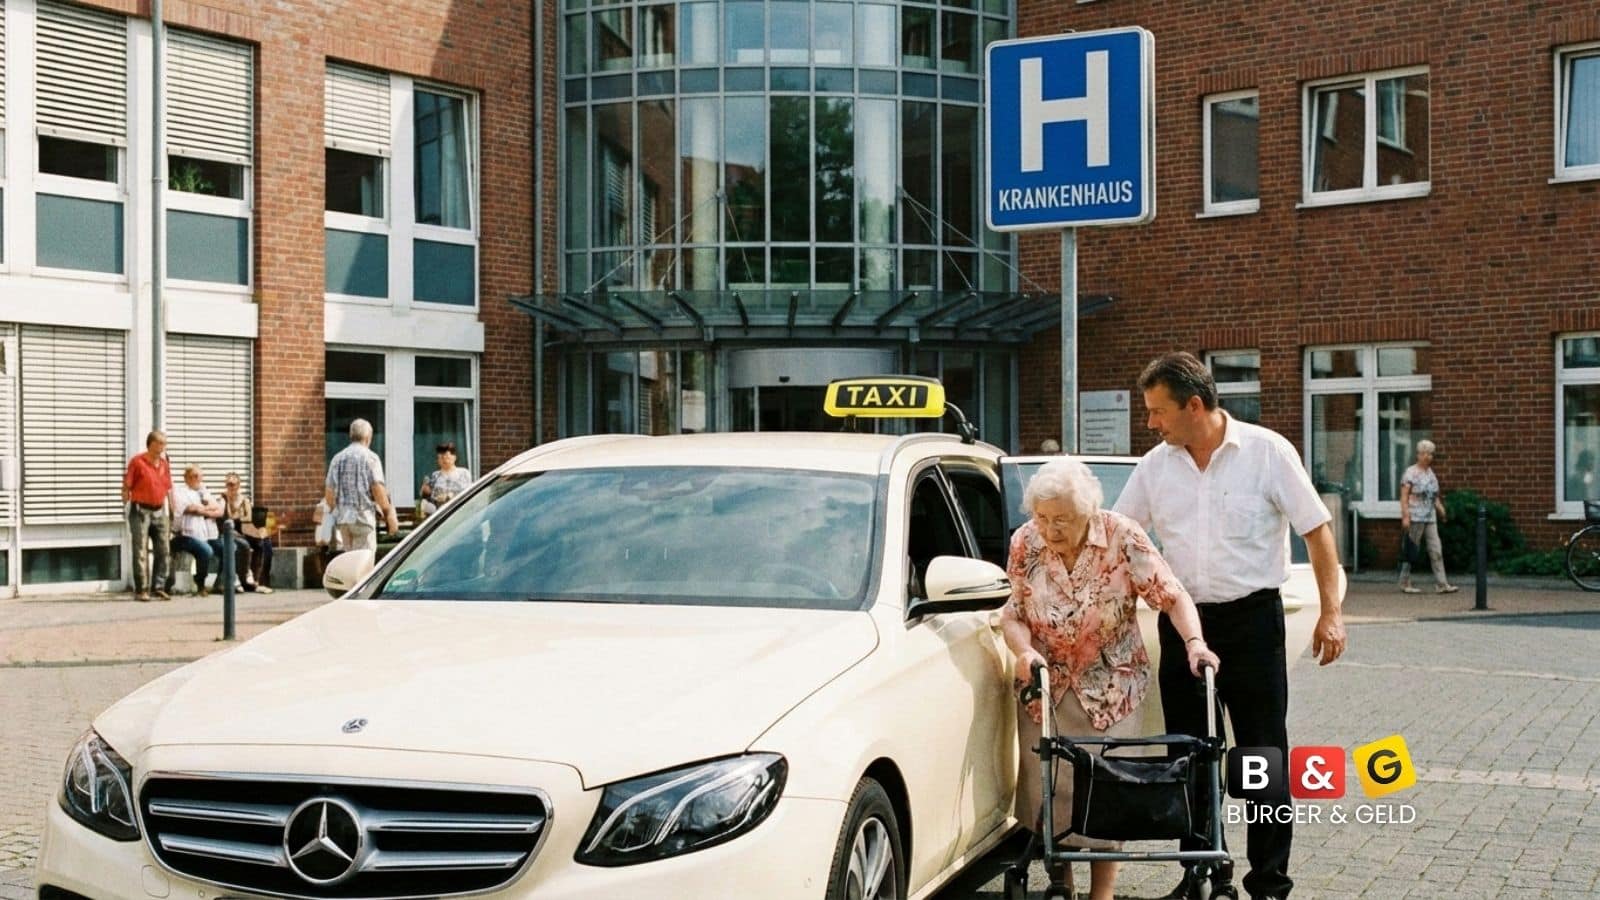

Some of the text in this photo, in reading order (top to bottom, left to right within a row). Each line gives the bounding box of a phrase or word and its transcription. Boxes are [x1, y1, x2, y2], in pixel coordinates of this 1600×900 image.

[1020, 50, 1110, 173] H
[999, 180, 1133, 211] KRANKENHAUS
[846, 386, 918, 406] TAXI
